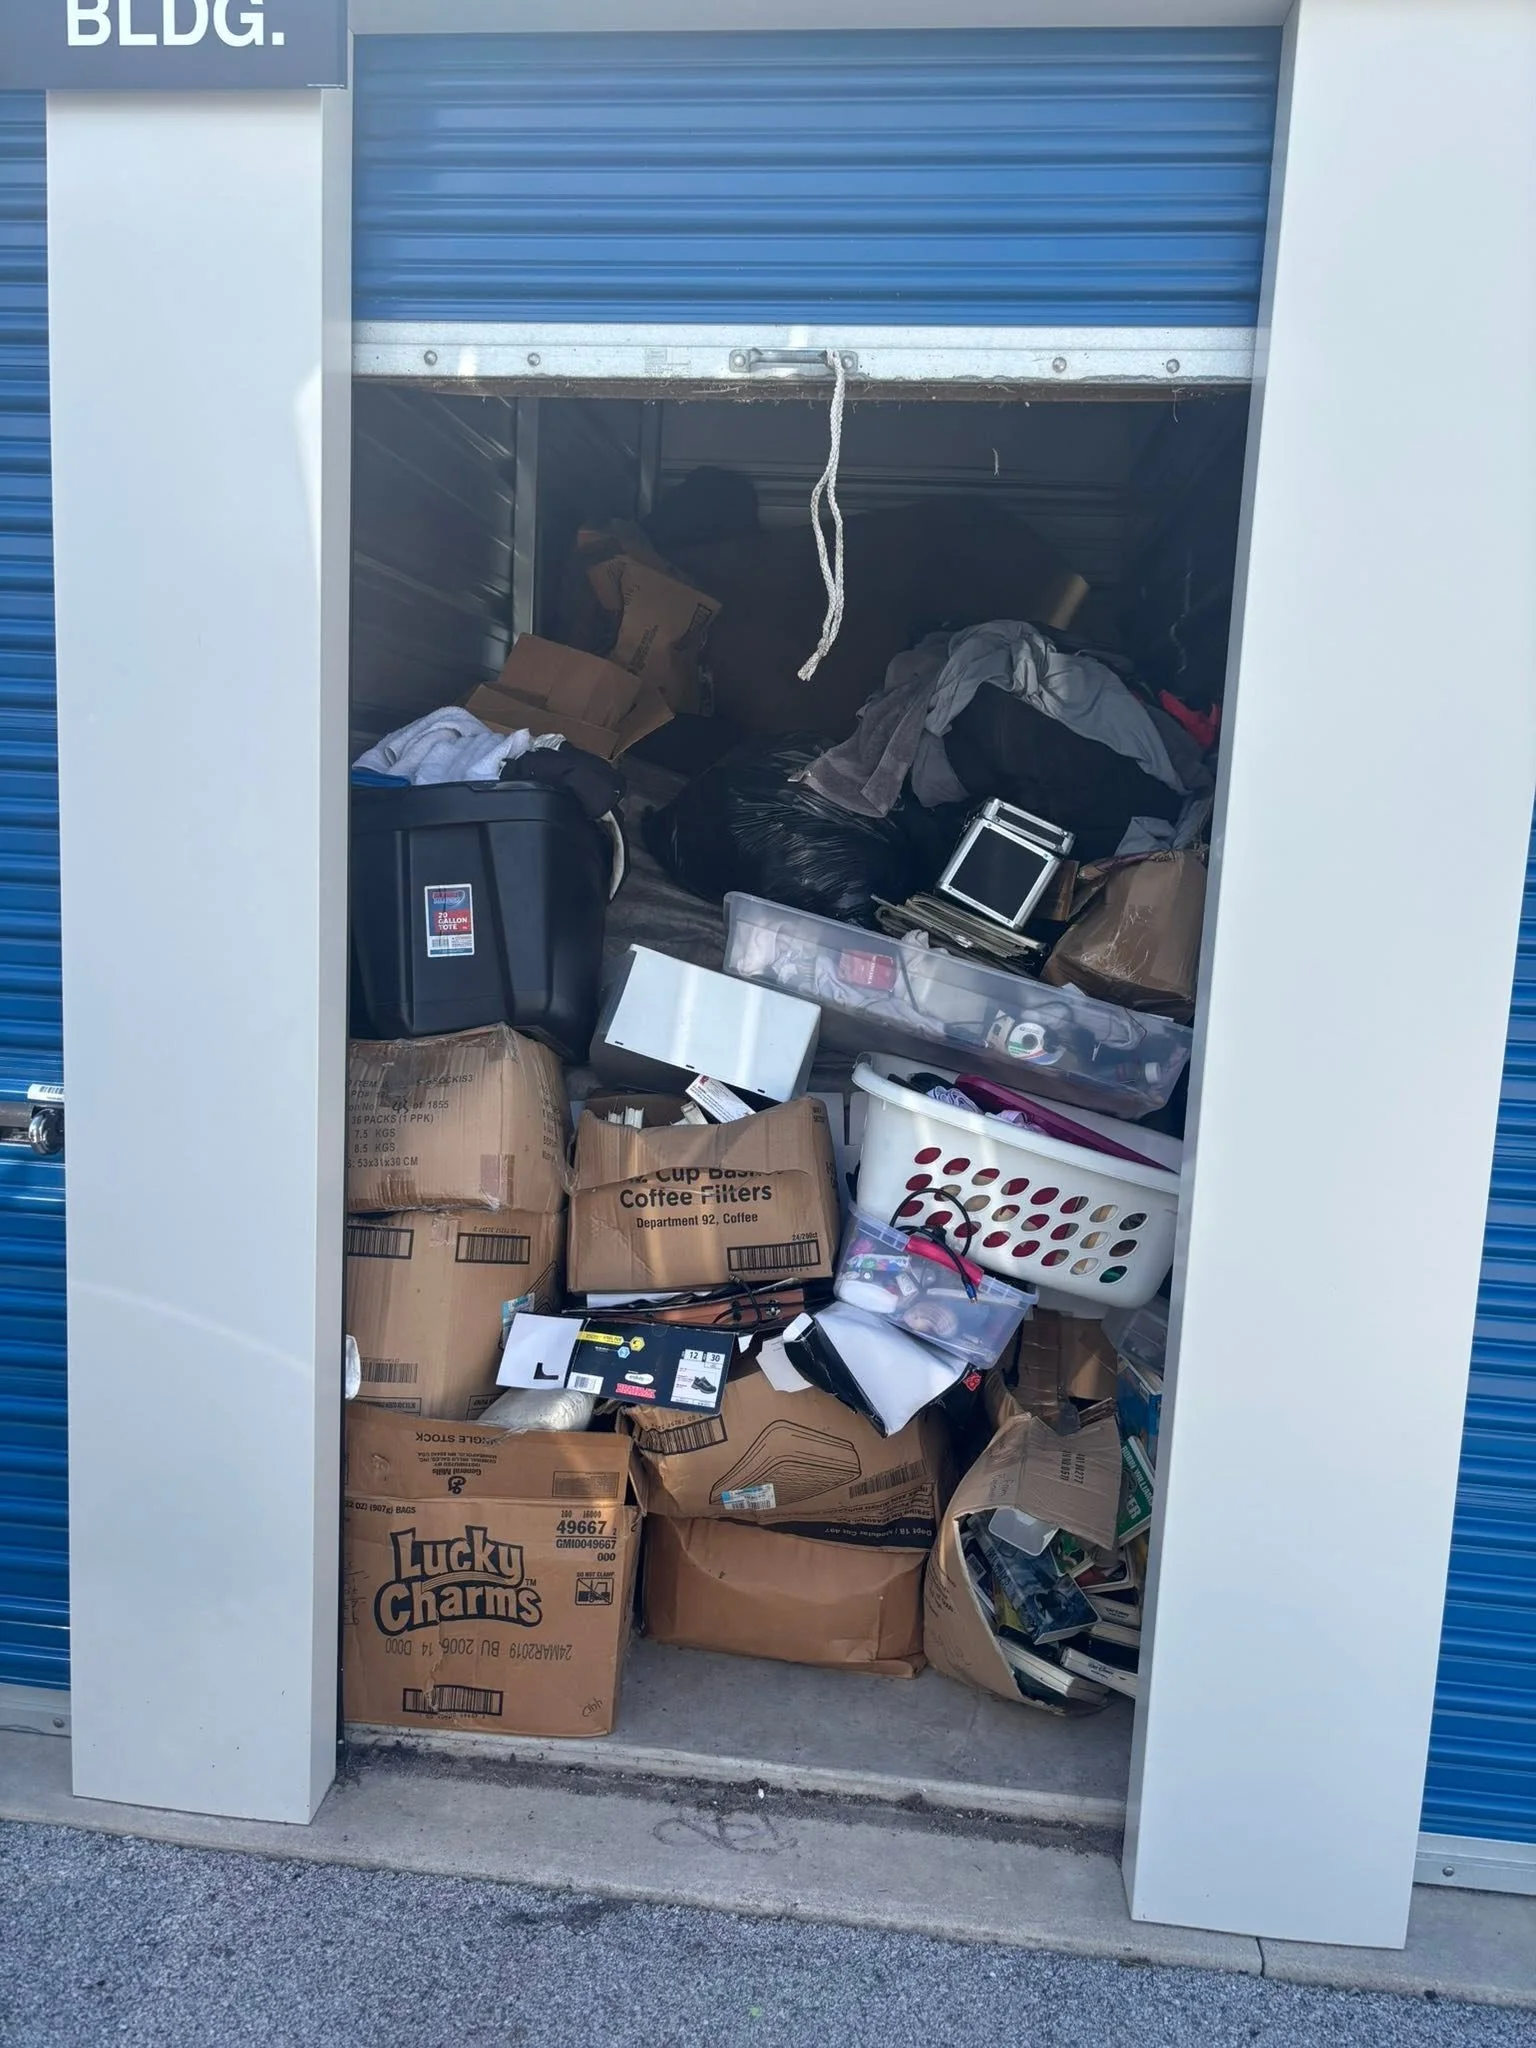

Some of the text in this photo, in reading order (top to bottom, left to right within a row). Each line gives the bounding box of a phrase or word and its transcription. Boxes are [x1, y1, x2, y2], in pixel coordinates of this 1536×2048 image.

[67, 0, 285, 47] BLDG.
[427, 1100, 449, 1109] 1855
[363, 1114, 397, 1125] PACKS
[355, 1128, 396, 1139] 7.5 KGS
[354, 1142, 396, 1153] 8.5 KGS
[403, 1156, 418, 1166] CM
[655, 1168, 700, 1185] Cup
[708, 1168, 782, 1180] Bas
[620, 1184, 772, 1209] Coffee Filters
[636, 1212, 758, 1230] Department 92, Coffee
[689, 1351, 721, 1362] 12 30
[415, 1432, 456, 1443] STOCK
[1121, 1445, 1137, 1470] ROBIN
[395, 1506, 416, 1514] BAGS
[556, 1520, 617, 1536] 49667 2
[899, 1528, 910, 1536] 18
[912, 1527, 932, 1536] Dept
[556, 1539, 617, 1550] GMI0049667
[390, 1525, 524, 1588] Lucky
[597, 1552, 616, 1562] 000
[374, 1575, 542, 1636] Charms
[421, 1641, 434, 1656] 14
[509, 1643, 573, 1661] 24MAR2019
